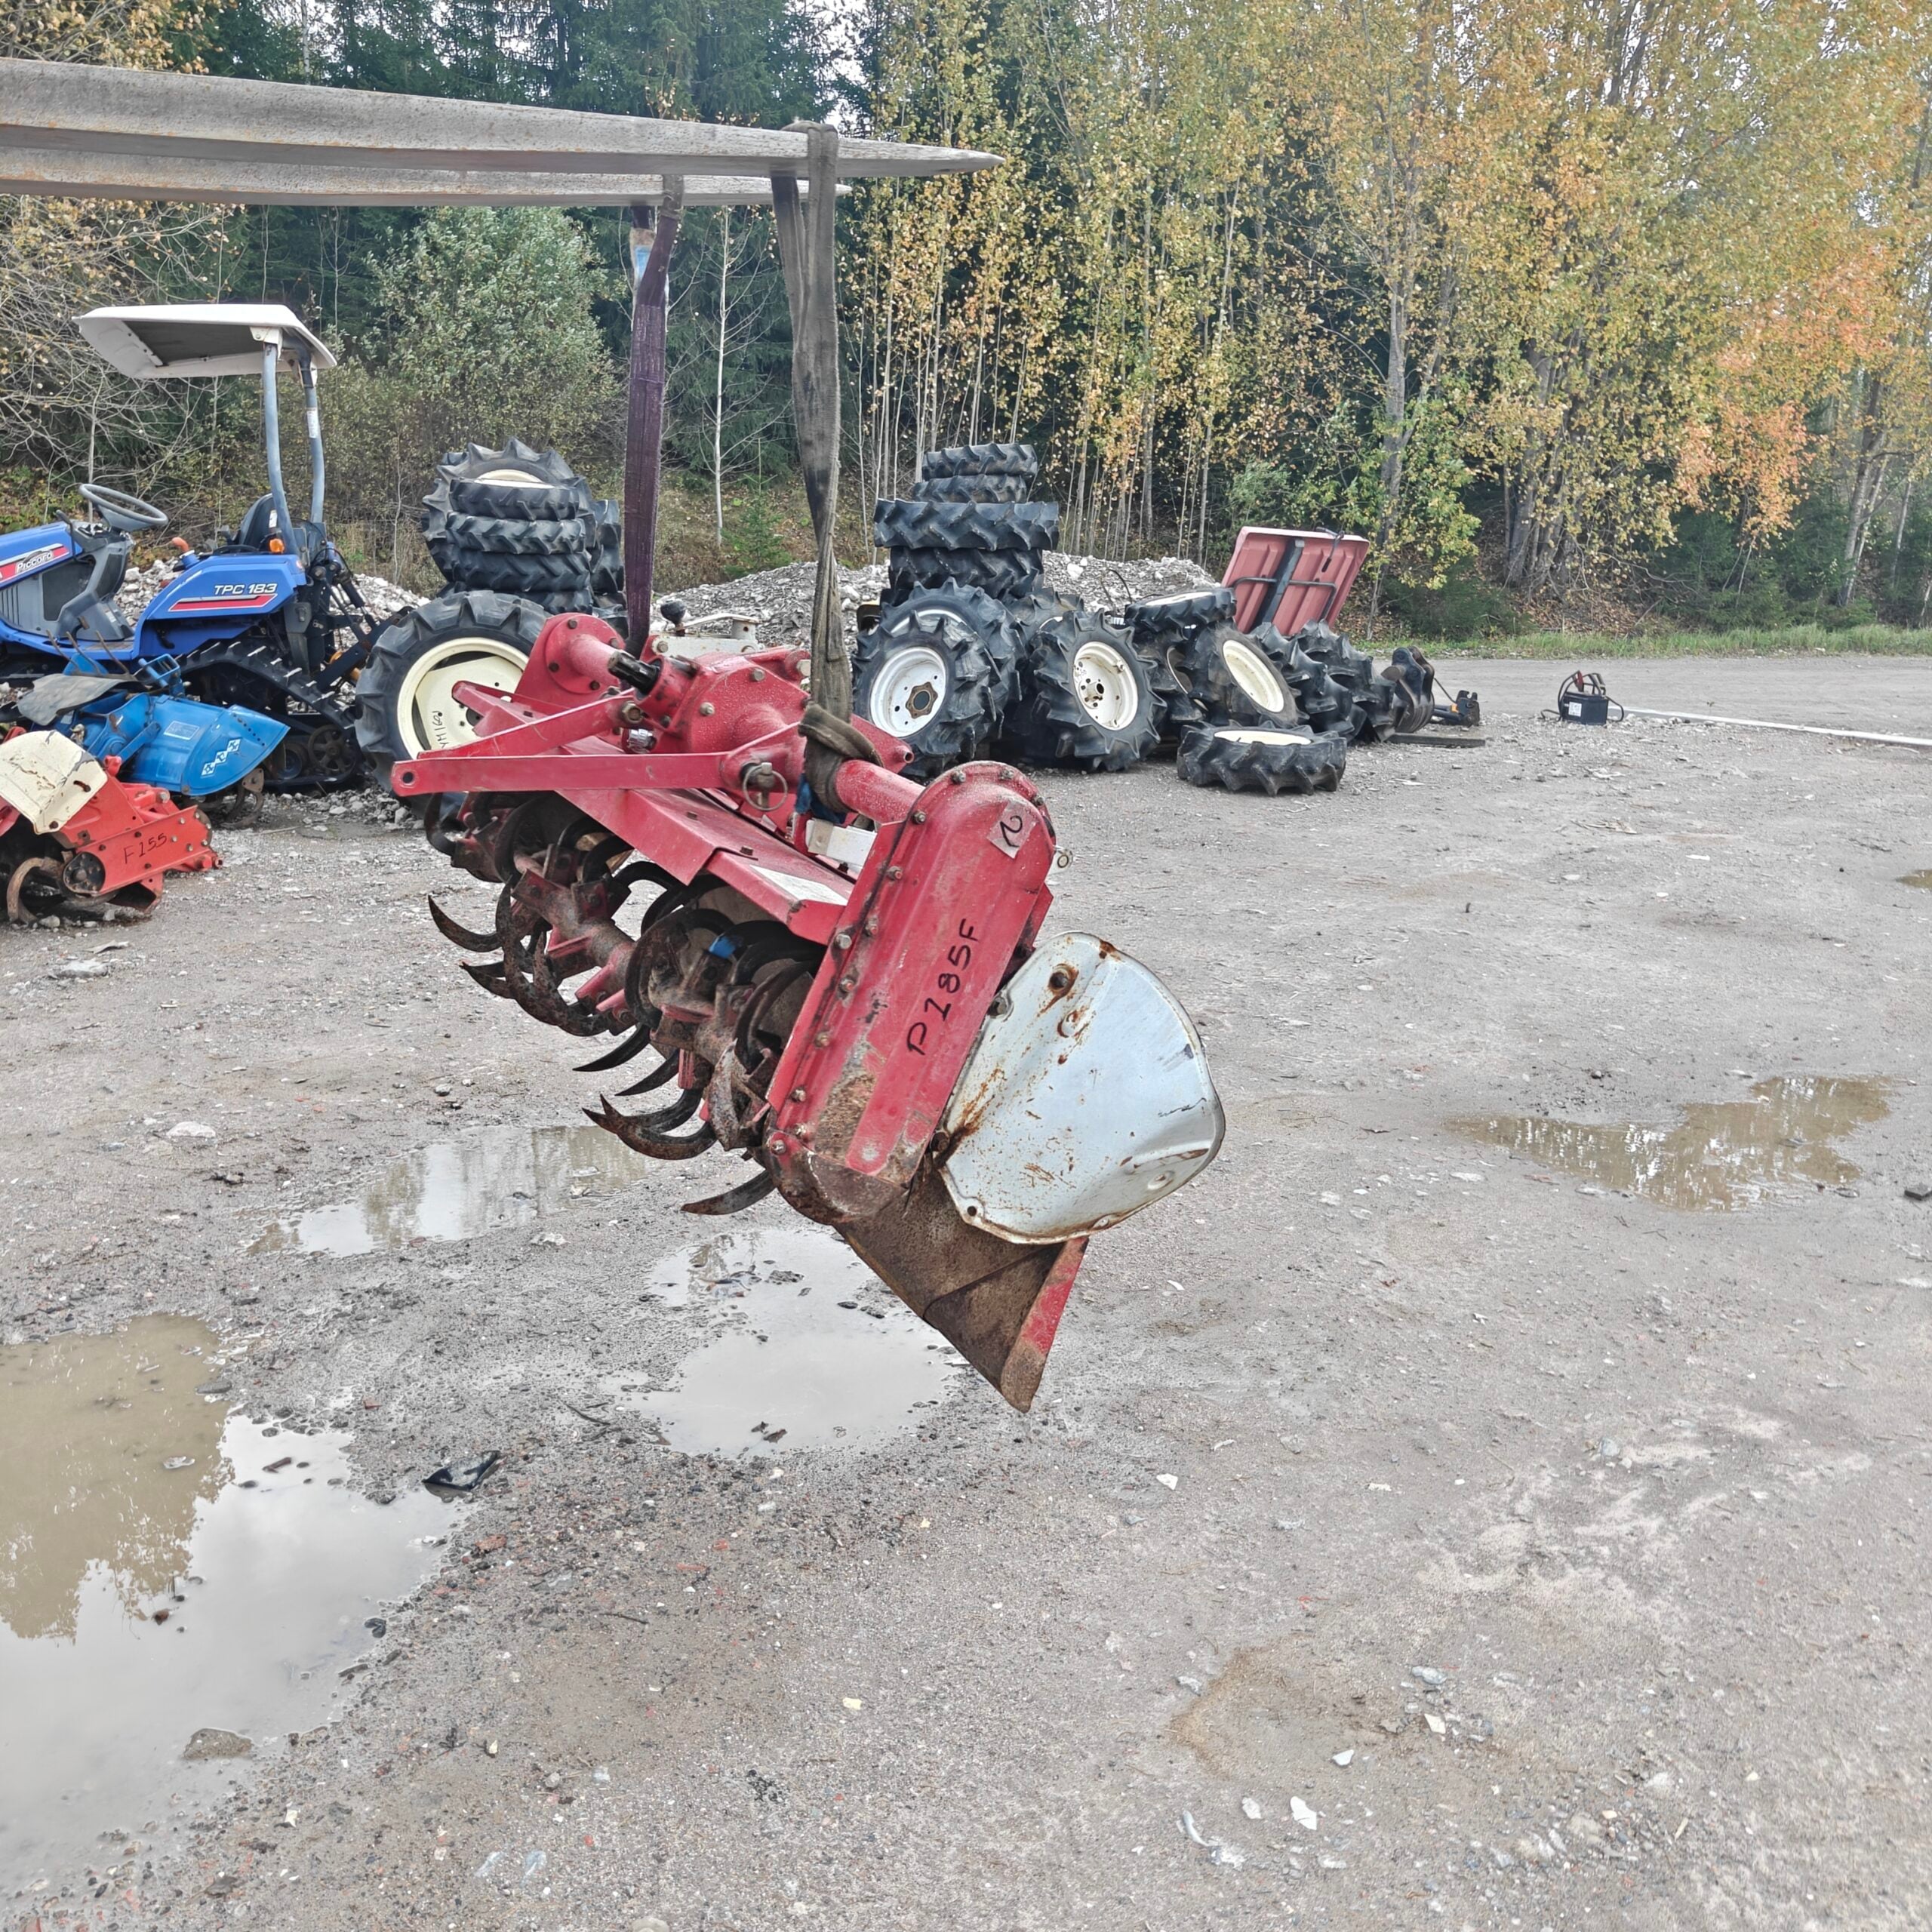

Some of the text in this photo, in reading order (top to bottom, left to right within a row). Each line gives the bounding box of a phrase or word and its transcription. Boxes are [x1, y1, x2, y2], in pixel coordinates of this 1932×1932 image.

[214, 583, 277, 595] TPC 183
[124, 832, 167, 864] F155
[907, 918, 979, 1055] P185F
